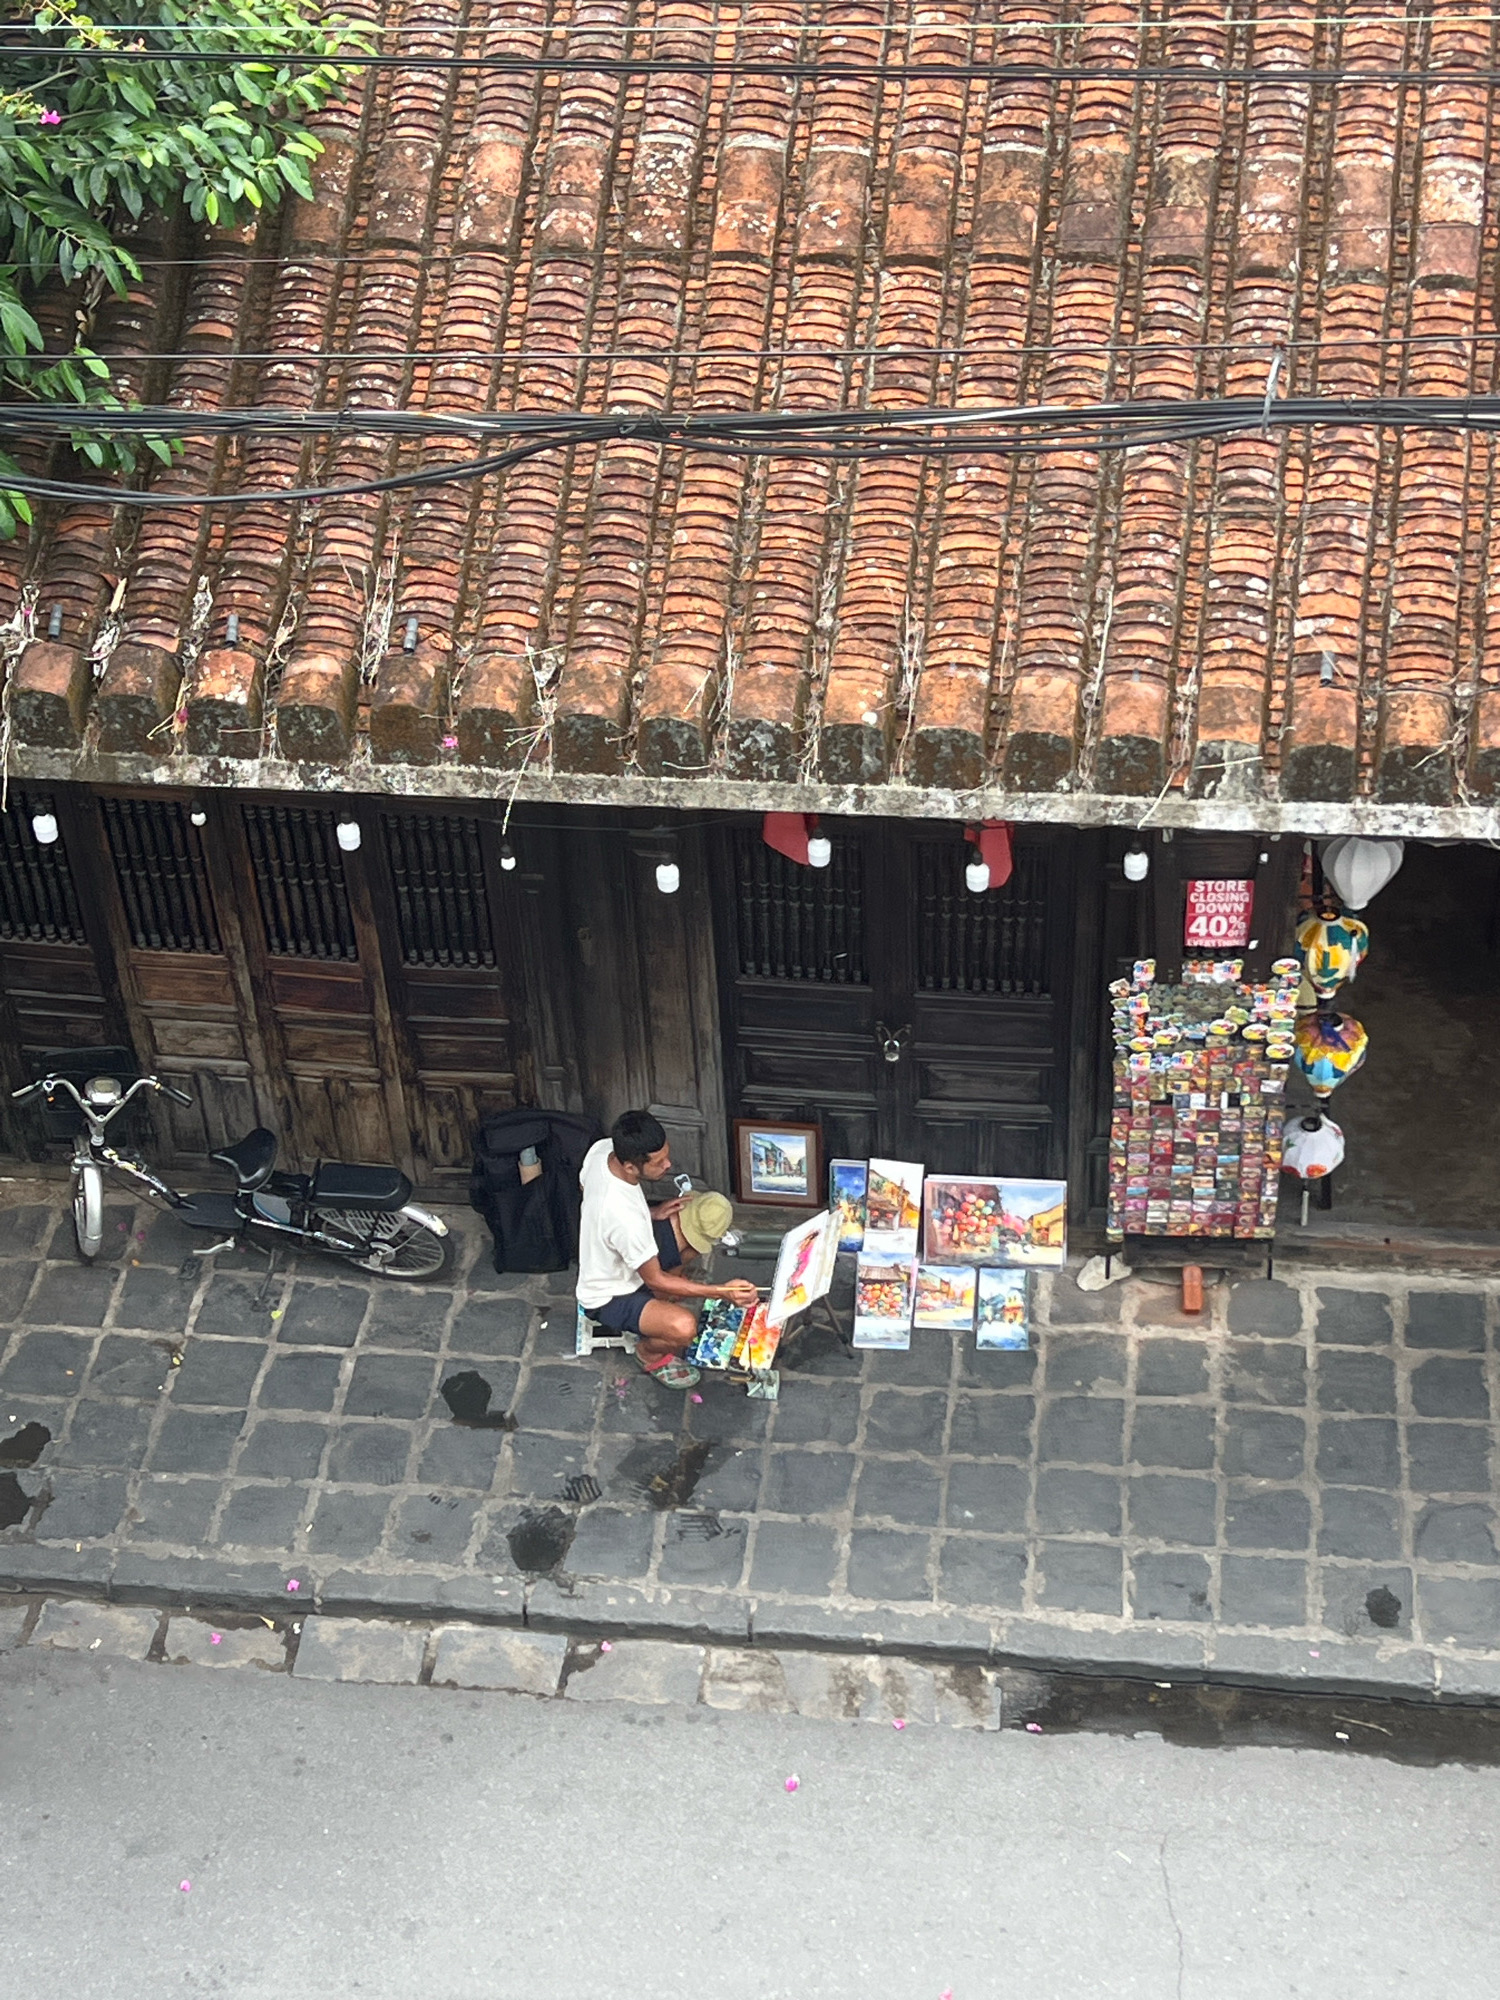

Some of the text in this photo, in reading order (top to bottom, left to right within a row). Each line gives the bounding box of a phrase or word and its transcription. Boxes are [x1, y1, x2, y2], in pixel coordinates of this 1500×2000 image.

[1195, 880, 1247, 892] STORE
[1190, 892, 1249, 903] CLOSING
[1196, 903, 1244, 913] DOWN
[1188, 915, 1246, 936] 40%
